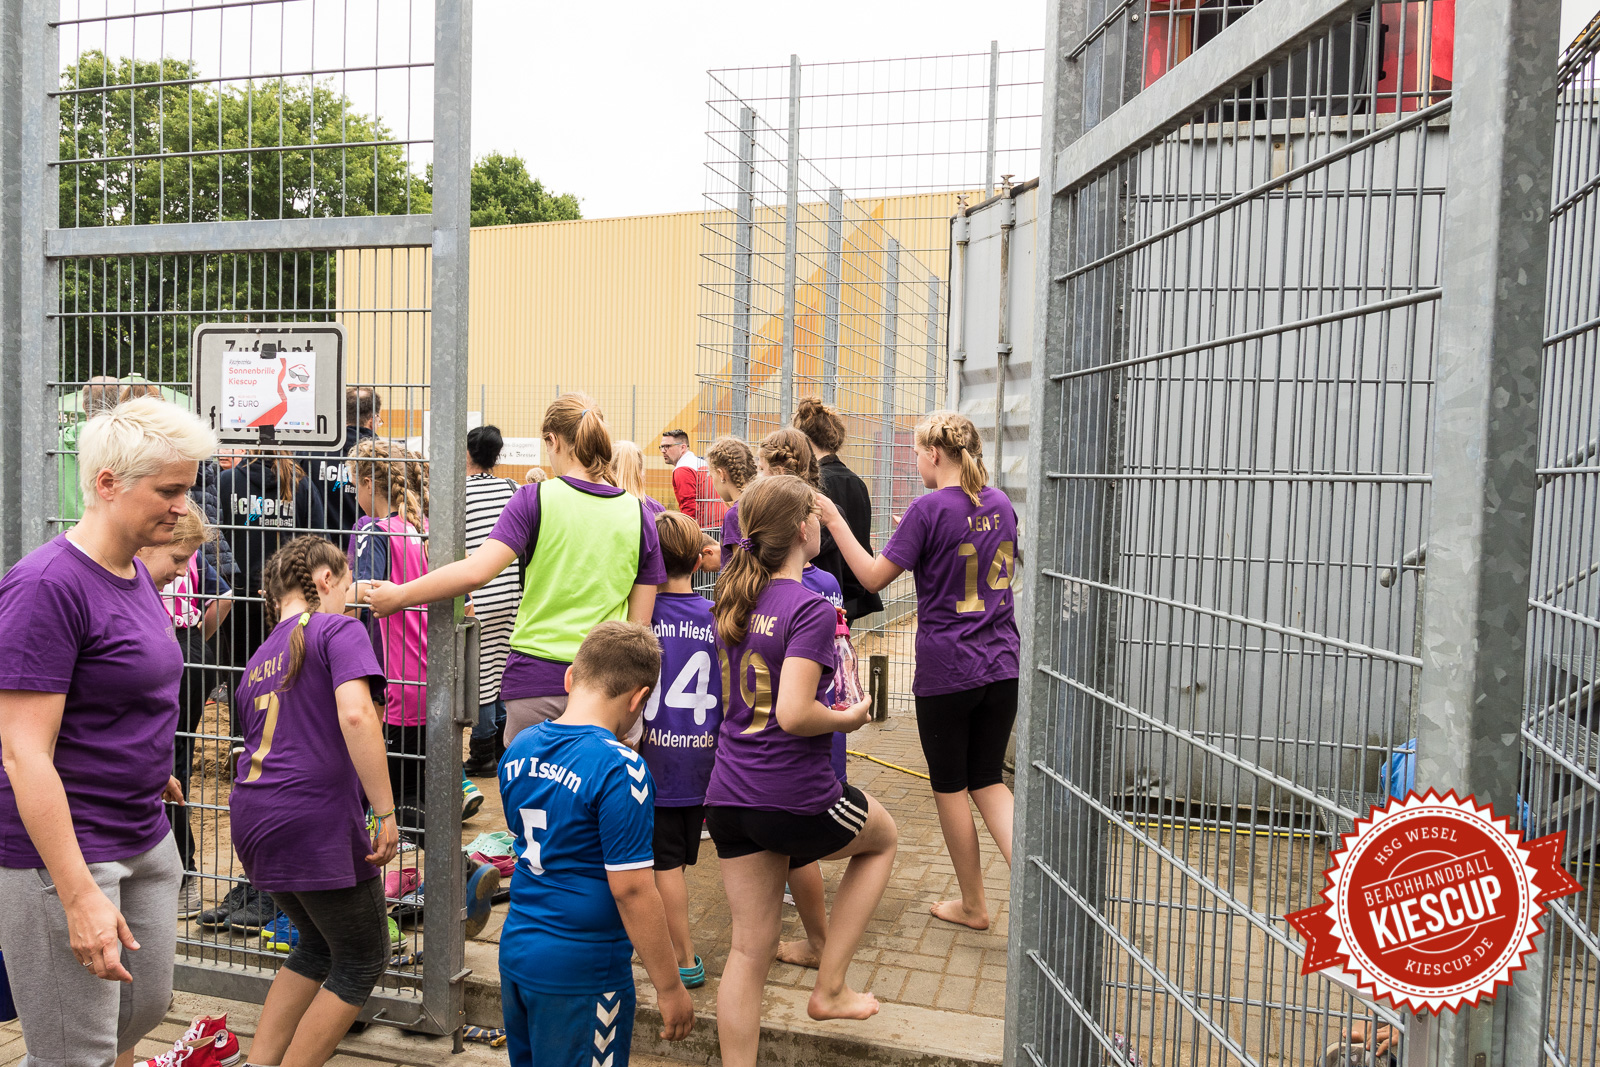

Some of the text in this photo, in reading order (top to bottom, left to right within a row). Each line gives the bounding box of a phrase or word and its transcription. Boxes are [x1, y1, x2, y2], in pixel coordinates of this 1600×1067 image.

[228, 367, 276, 375] Sonnenbrille
[228, 378, 258, 386] Kiescup
[228, 396, 235, 407] 3
[967, 513, 1000, 532] LEA F
[956, 541, 1014, 613] 14
[679, 620, 715, 643] Hiesfe
[241, 691, 280, 783] 7
[648, 728, 714, 748] Aldenrade
[504, 756, 582, 794] TV Issum
[519, 808, 547, 876] 5
